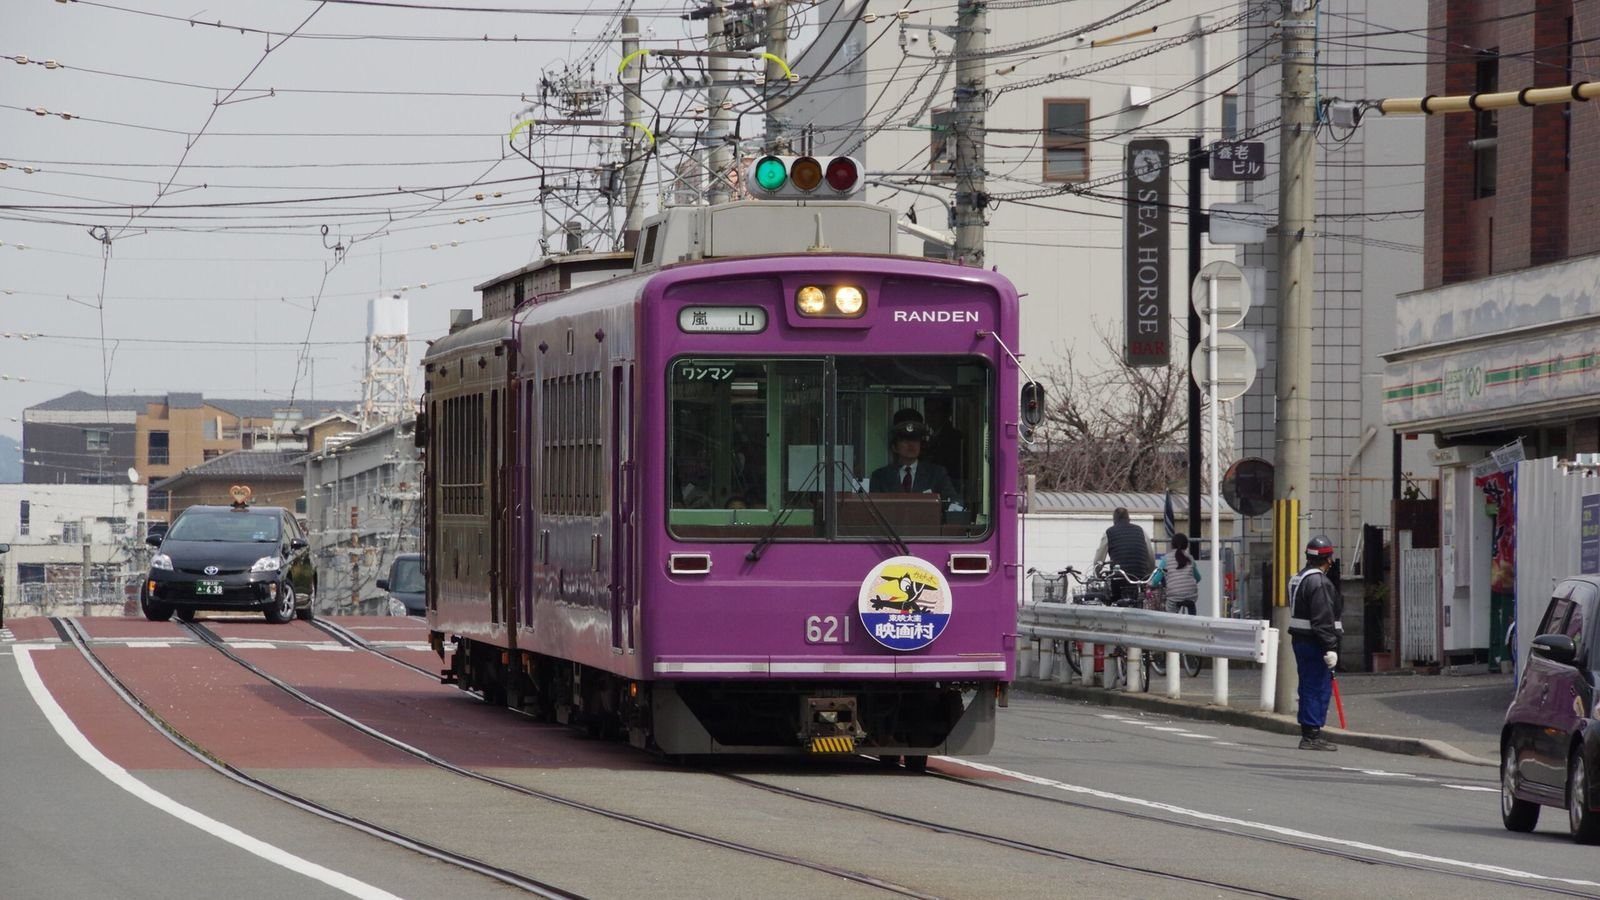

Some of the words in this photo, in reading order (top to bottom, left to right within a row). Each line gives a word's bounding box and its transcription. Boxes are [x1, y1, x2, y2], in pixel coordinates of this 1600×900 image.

[1232, 160, 1260, 174] ビル
[1138, 189, 1158, 239] SEA
[1138, 247, 1158, 334] HORSE
[894, 310, 979, 322] RANDEN
[1131, 341, 1165, 355] BAR
[682, 367, 734, 380] ワンマン
[806, 615, 850, 643] 621
[875, 622, 935, 639] 映画村
